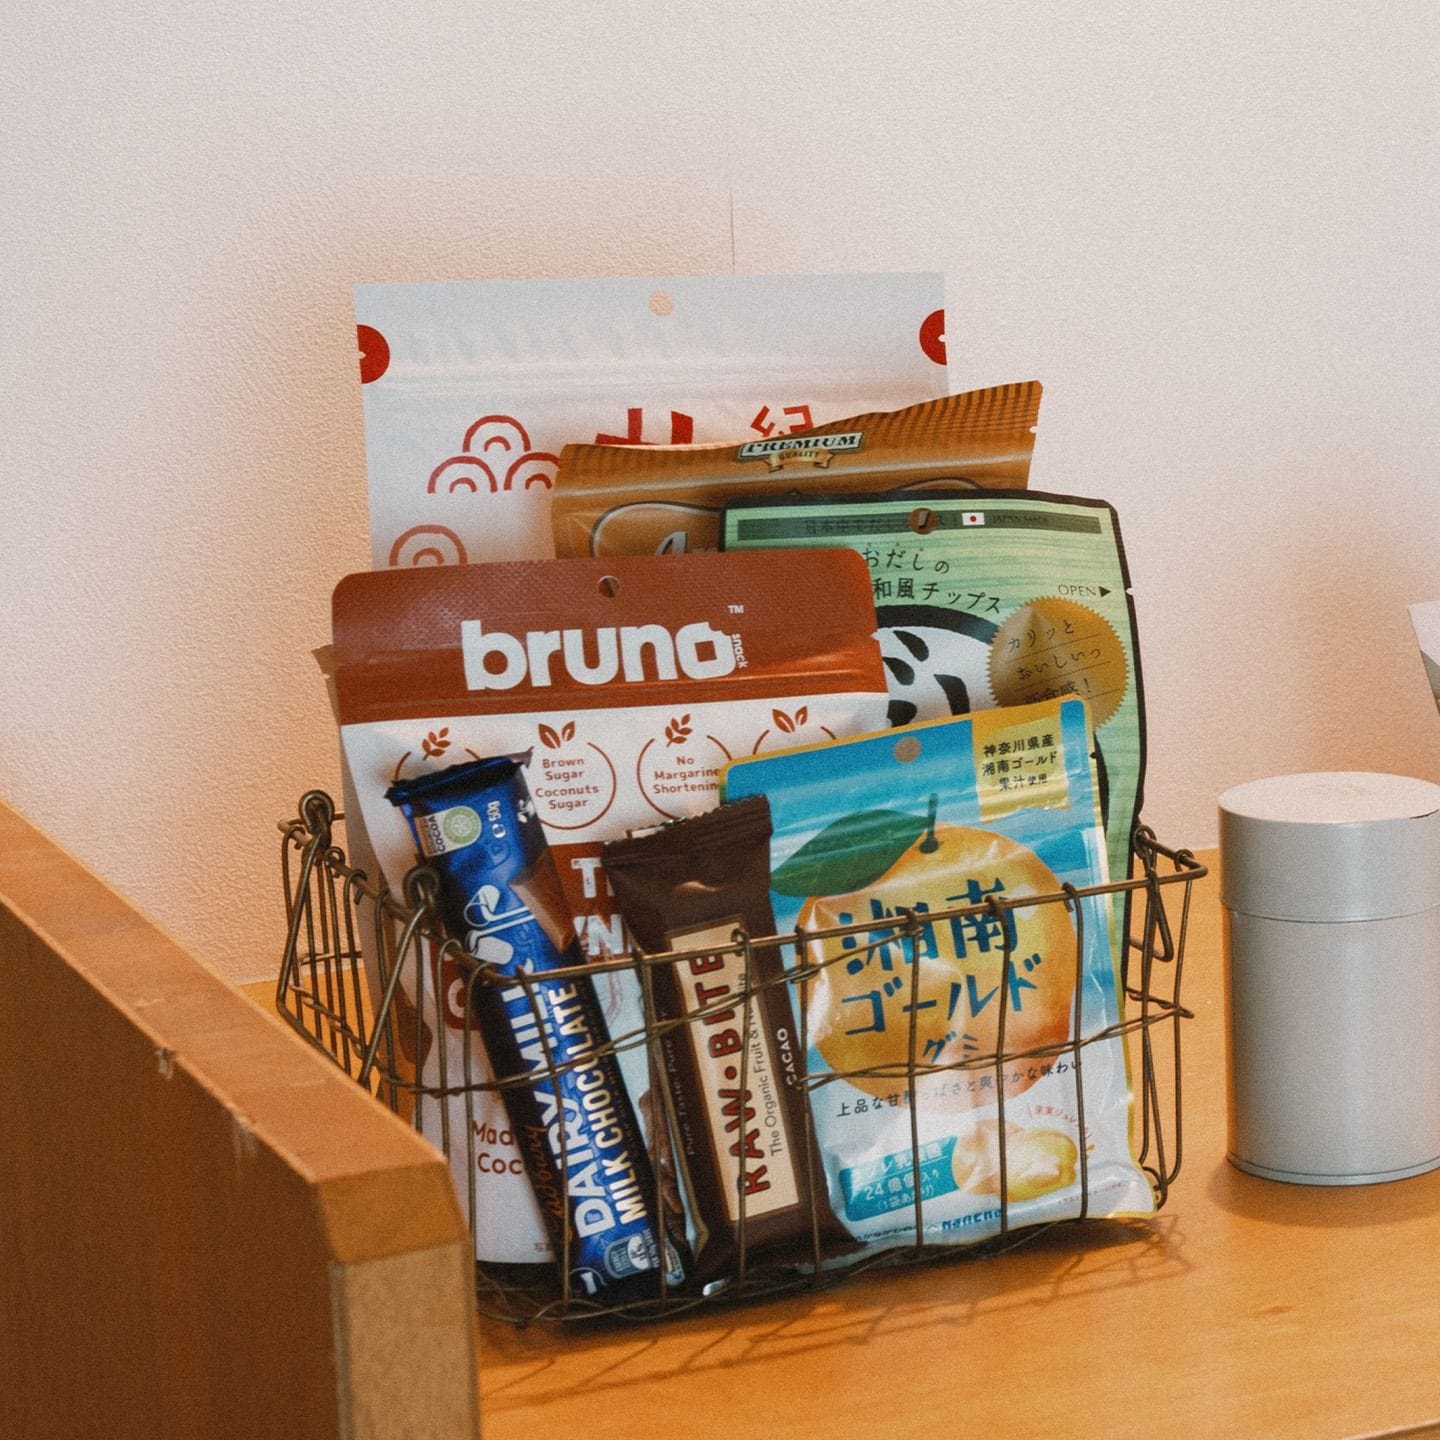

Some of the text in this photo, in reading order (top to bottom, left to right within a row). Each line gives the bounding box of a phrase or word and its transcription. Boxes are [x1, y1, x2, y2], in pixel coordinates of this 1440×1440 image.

[747, 433, 858, 453] PREMIUM
[873, 577, 1000, 614] 和風チップス
[1058, 584, 1097, 597] OPEN
[461, 620, 736, 691] bruno
[731, 633, 749, 668] snack
[983, 733, 1055, 758] 神奈川県産
[542, 758, 585, 769] Brown
[676, 756, 695, 766] No
[982, 750, 1057, 776] 湘南ゴールド
[535, 784, 599, 799] Coconuts
[545, 770, 585, 783] Sugar
[653, 782, 719, 795] Shortenin
[549, 800, 588, 812] Sugar
[428, 815, 446, 853] COCOA
[837, 877, 1018, 976] 湘南
[841, 953, 1042, 1035] ゴールド
[548, 982, 624, 1150] CHOCOLATE
[750, 1041, 767, 1074] Fruit
[776, 1028, 799, 1086] CACAO
[757, 1074, 778, 1128] Organic
[472, 1121, 515, 1146] Mad
[769, 1130, 783, 1157] The
[533, 1089, 617, 1239] DAIRY
[601, 1150, 648, 1225] MILK
